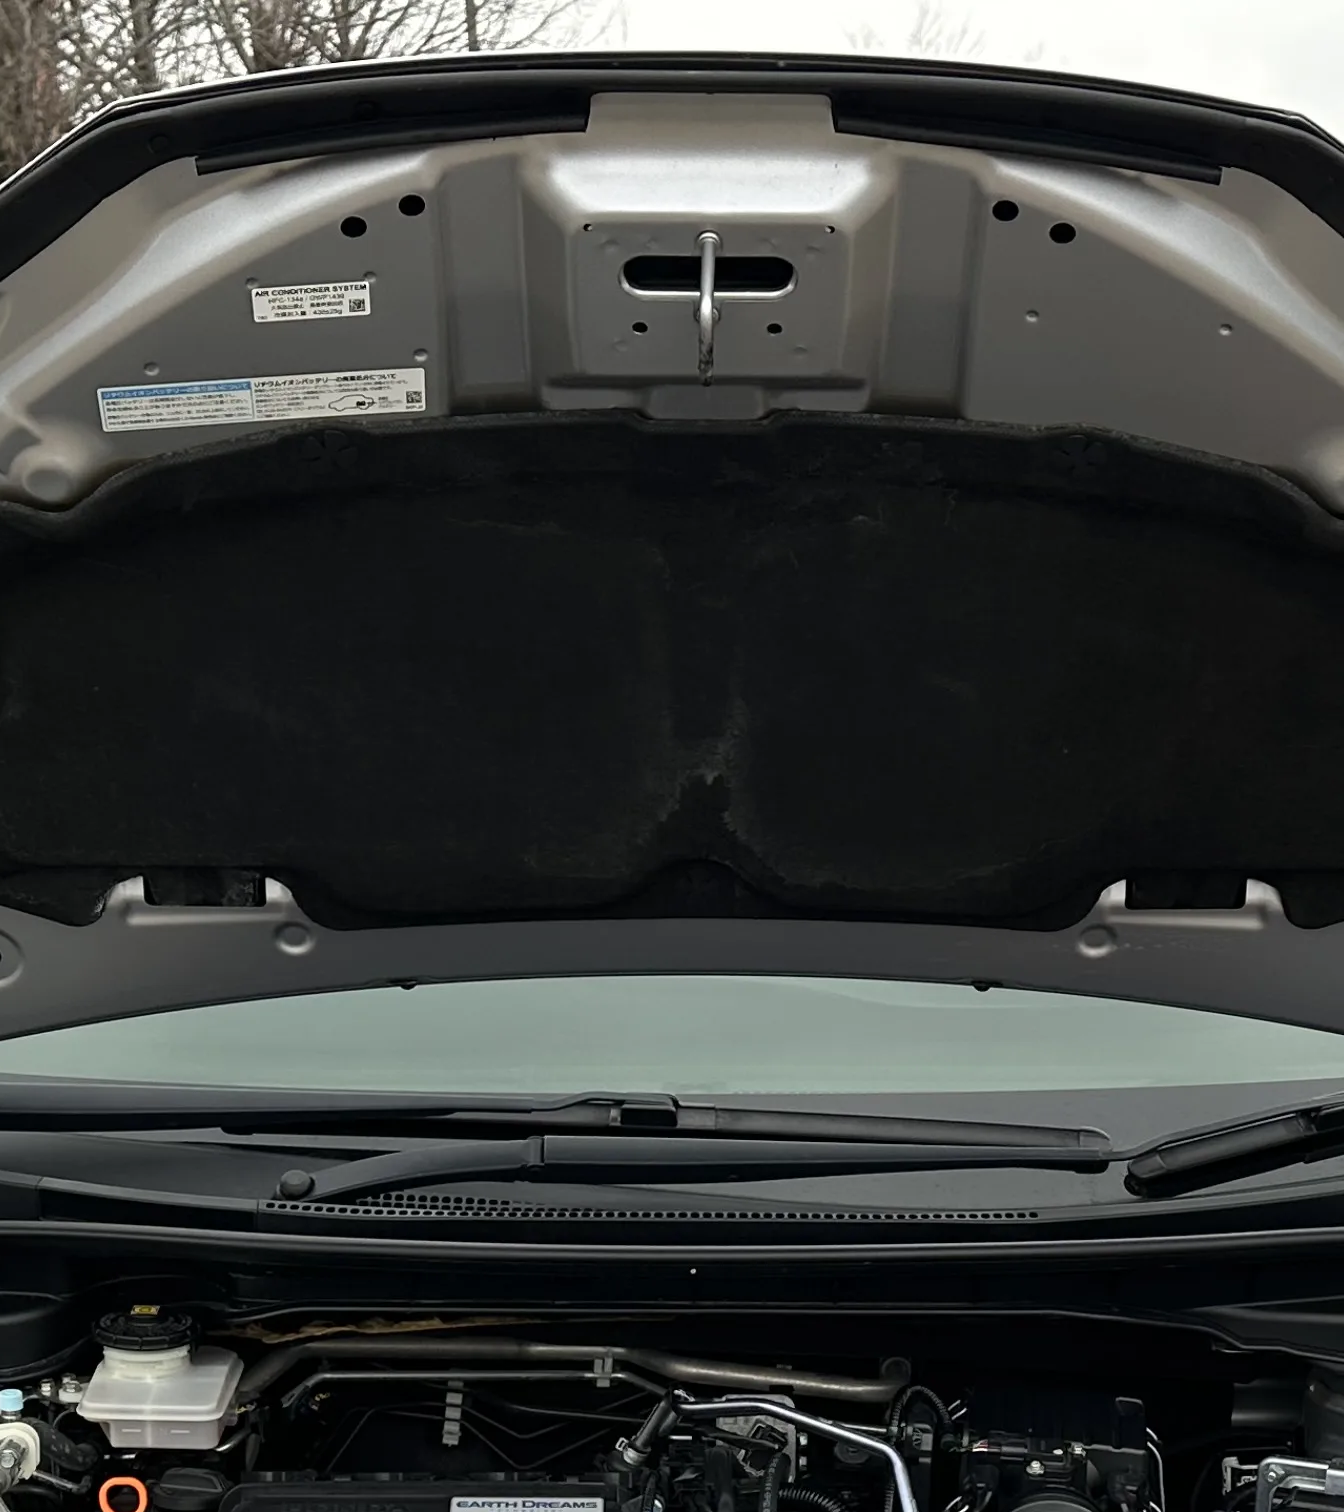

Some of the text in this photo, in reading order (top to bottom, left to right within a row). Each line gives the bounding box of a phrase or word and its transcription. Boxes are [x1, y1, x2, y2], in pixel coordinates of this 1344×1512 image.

[271, 287, 330, 296] CONDITIONER
[332, 284, 367, 292] SYSTEM
[456, 1501, 517, 1509] EARTH
